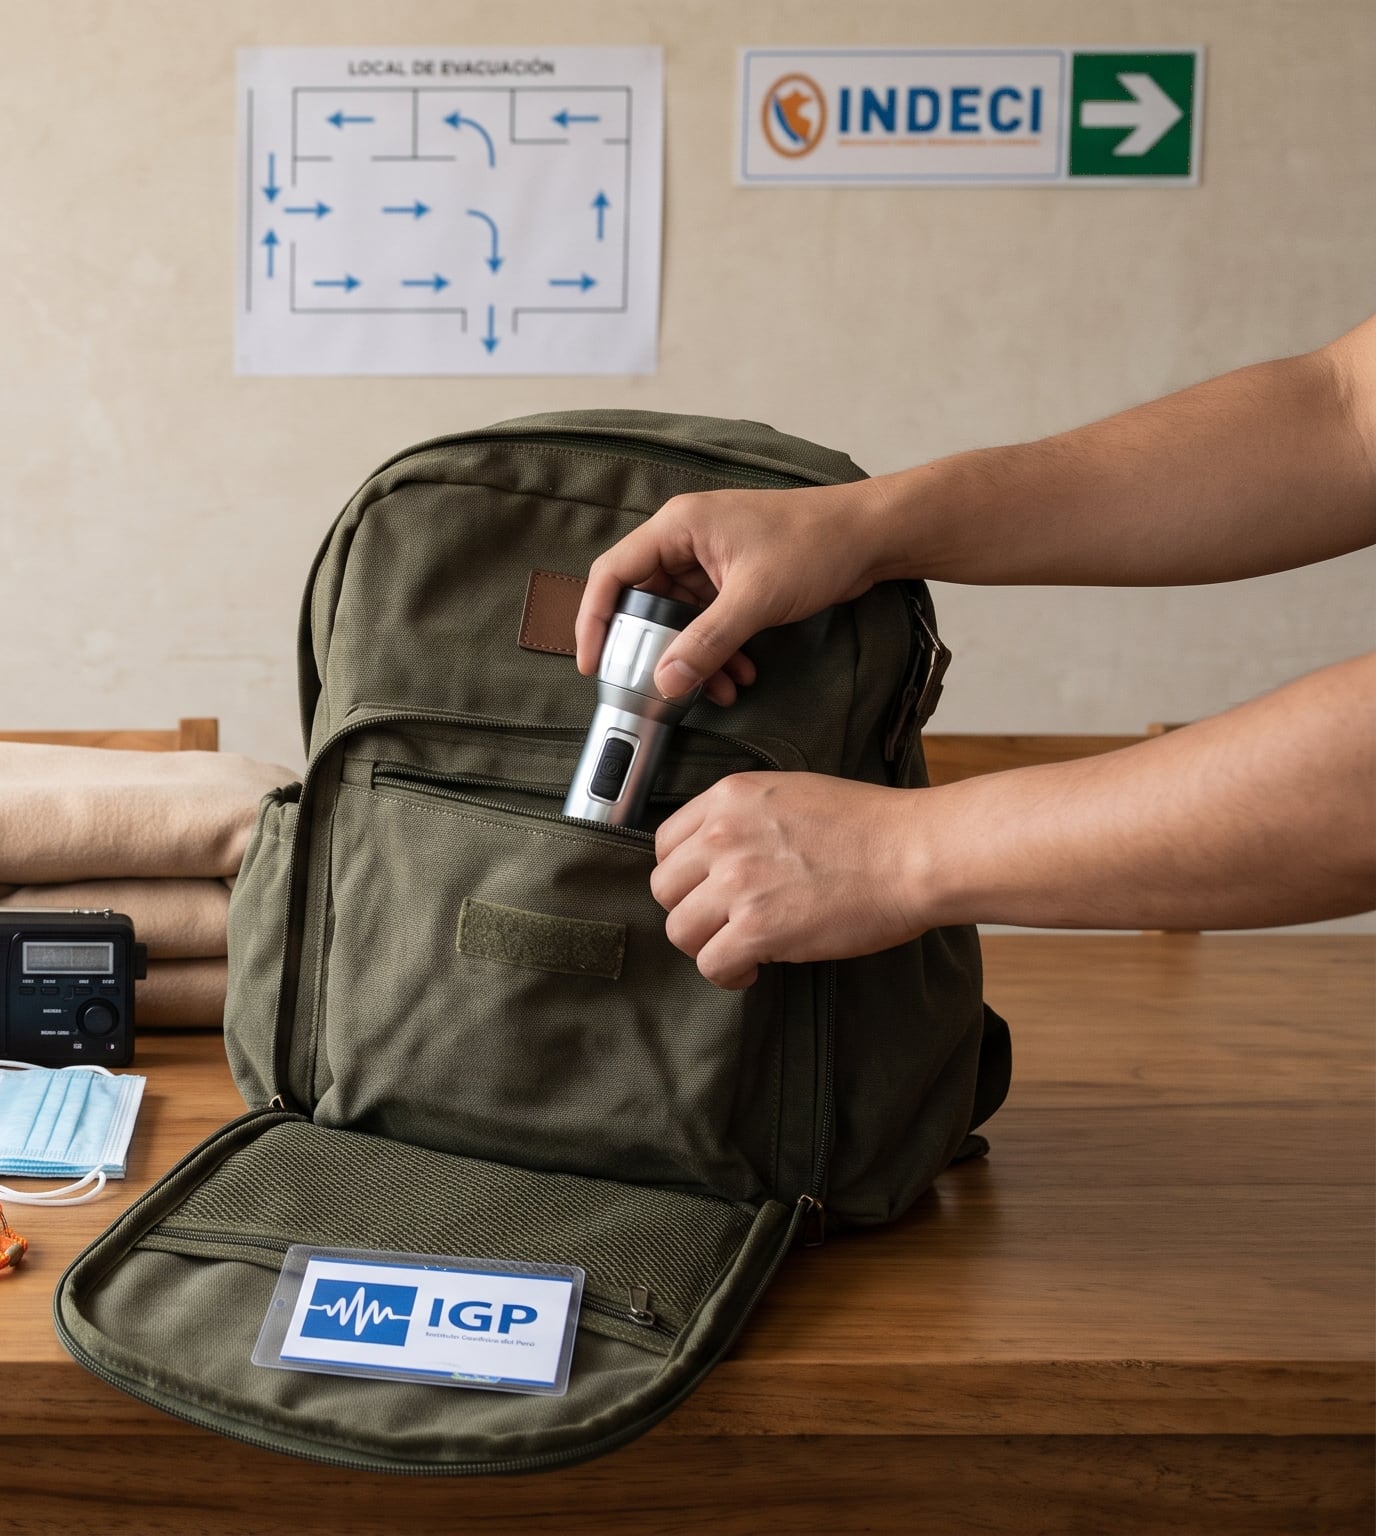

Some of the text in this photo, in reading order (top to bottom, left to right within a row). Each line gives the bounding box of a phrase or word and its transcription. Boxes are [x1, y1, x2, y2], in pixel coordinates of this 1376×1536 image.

[348, 55, 555, 76] LOCAL DE EVACUACIÓN
[838, 87, 1042, 133] INDECI
[428, 1298, 538, 1335] IGP
